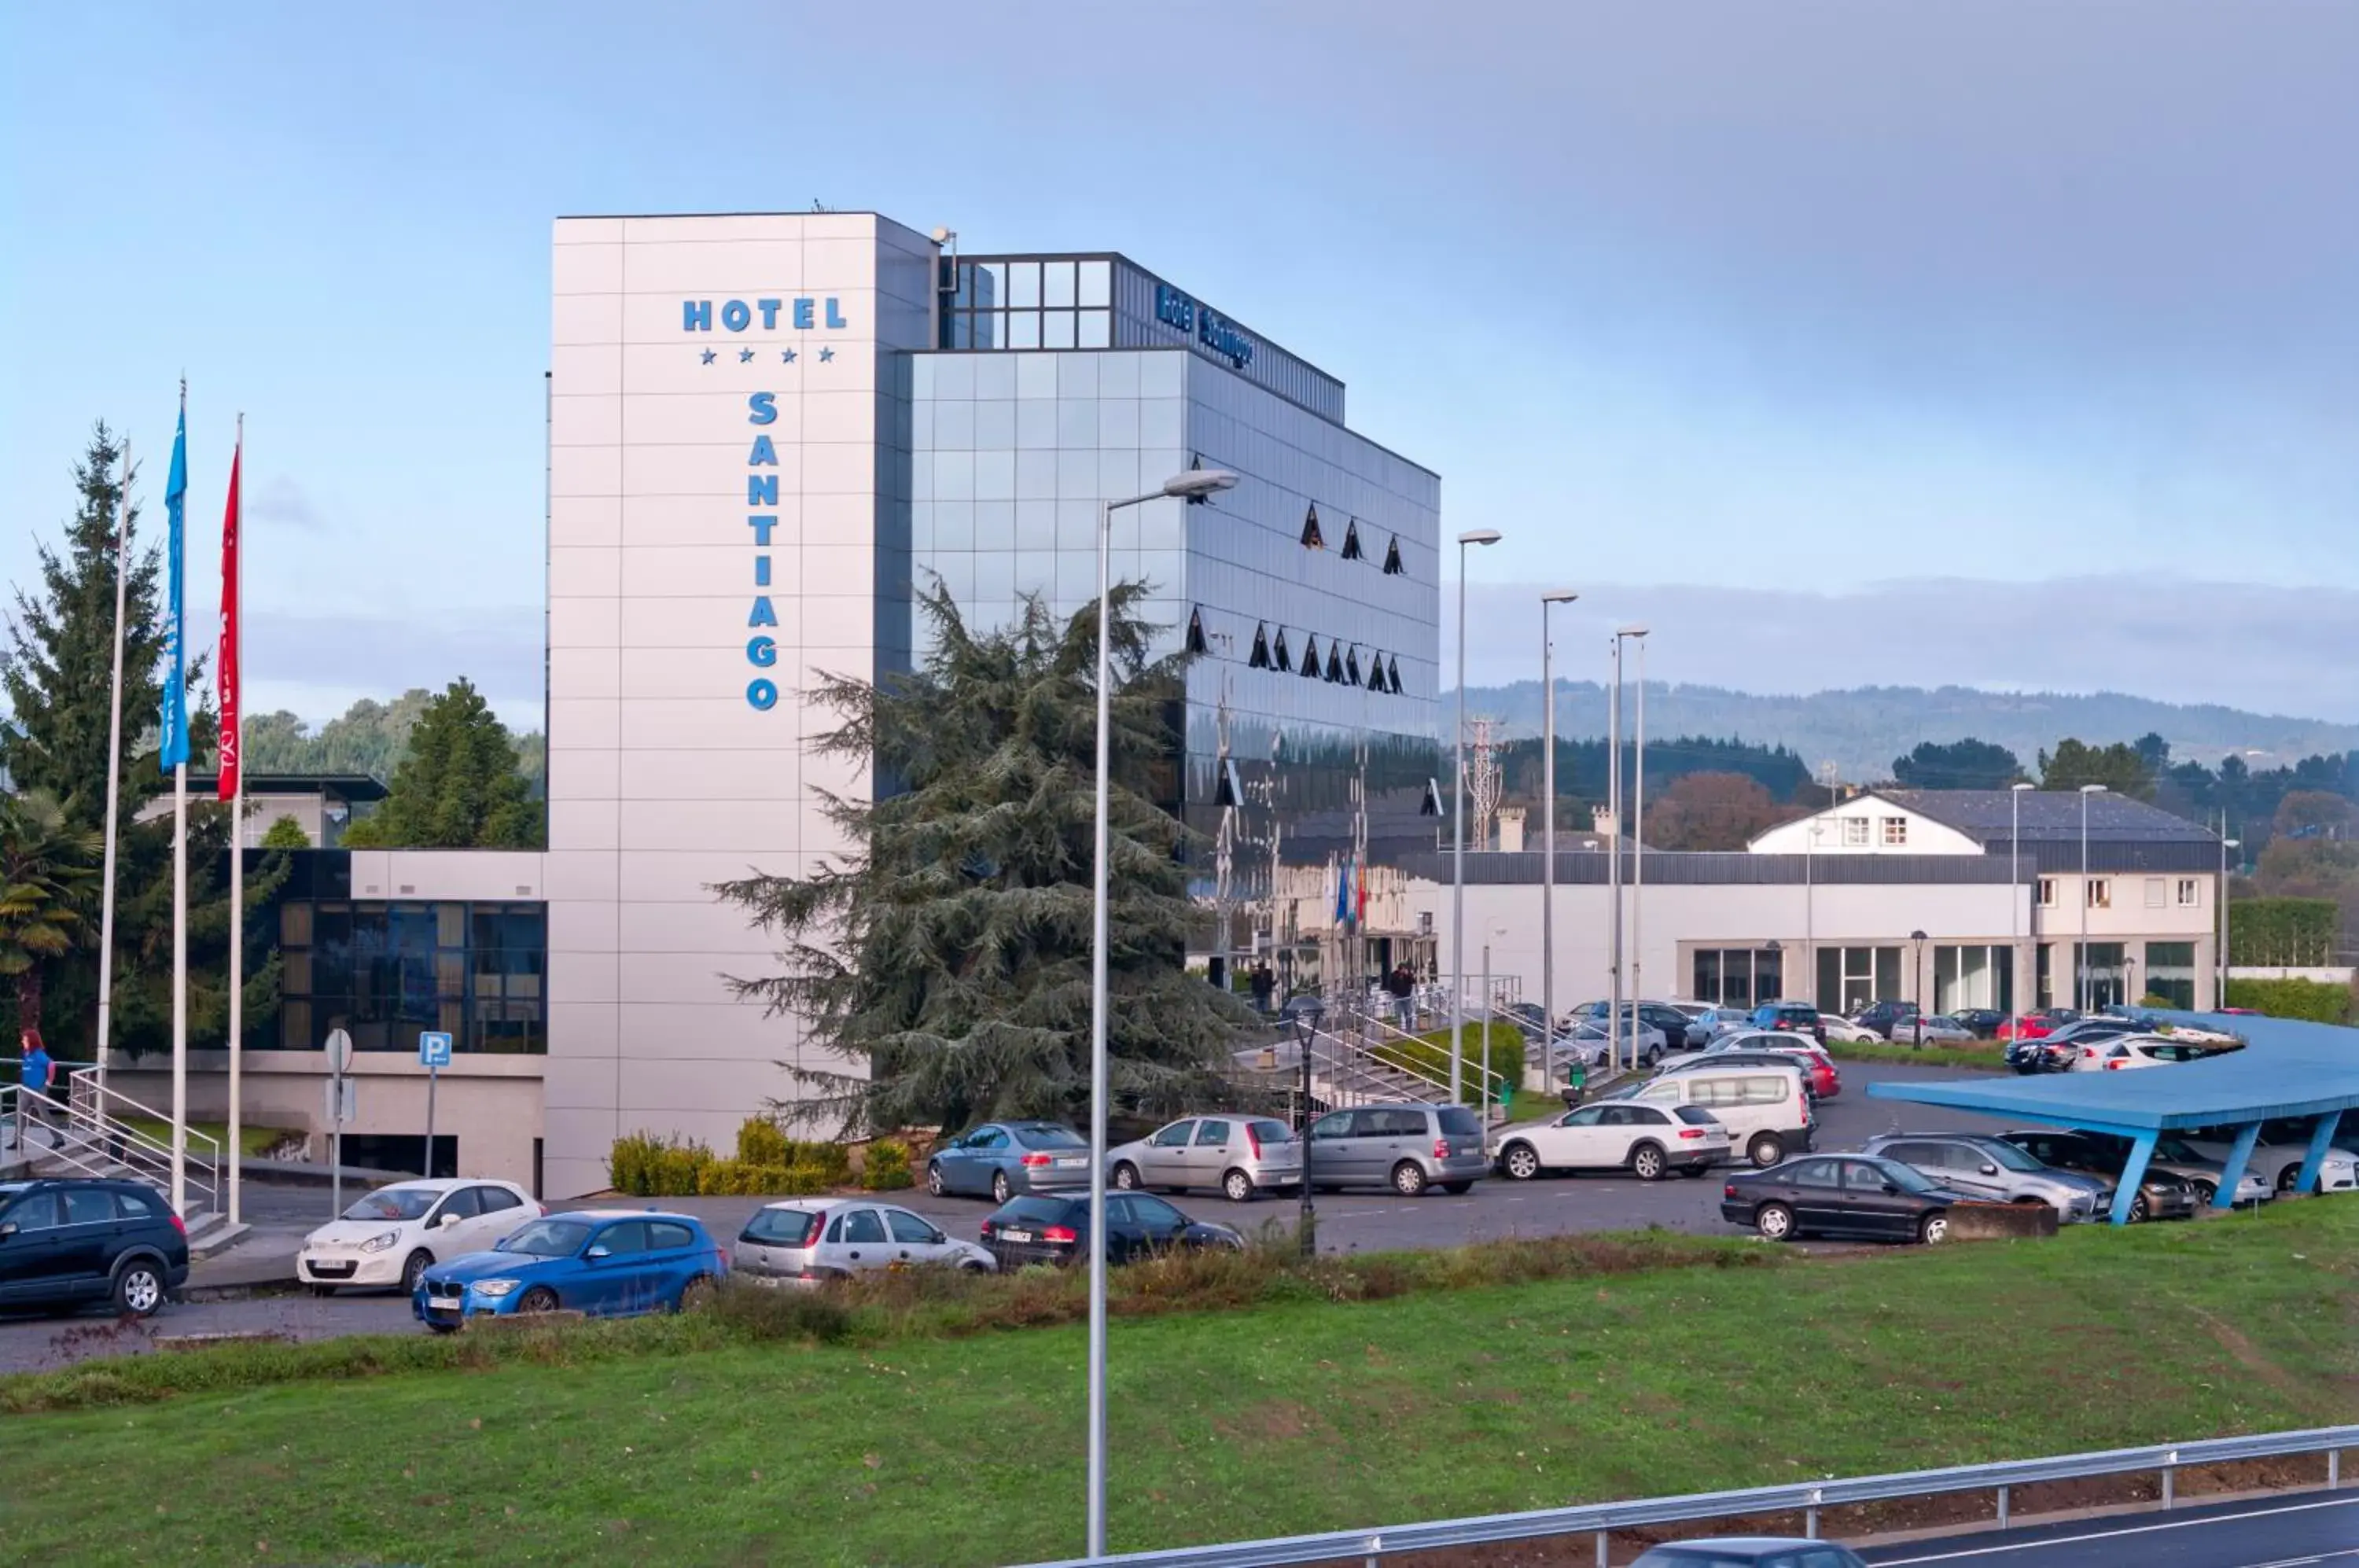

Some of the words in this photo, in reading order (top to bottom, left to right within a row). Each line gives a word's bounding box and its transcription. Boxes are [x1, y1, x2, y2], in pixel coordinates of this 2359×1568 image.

[683, 297, 847, 332] HOTEL
[746, 391, 778, 710] SANTIAGO
[426, 1036, 445, 1062] P
